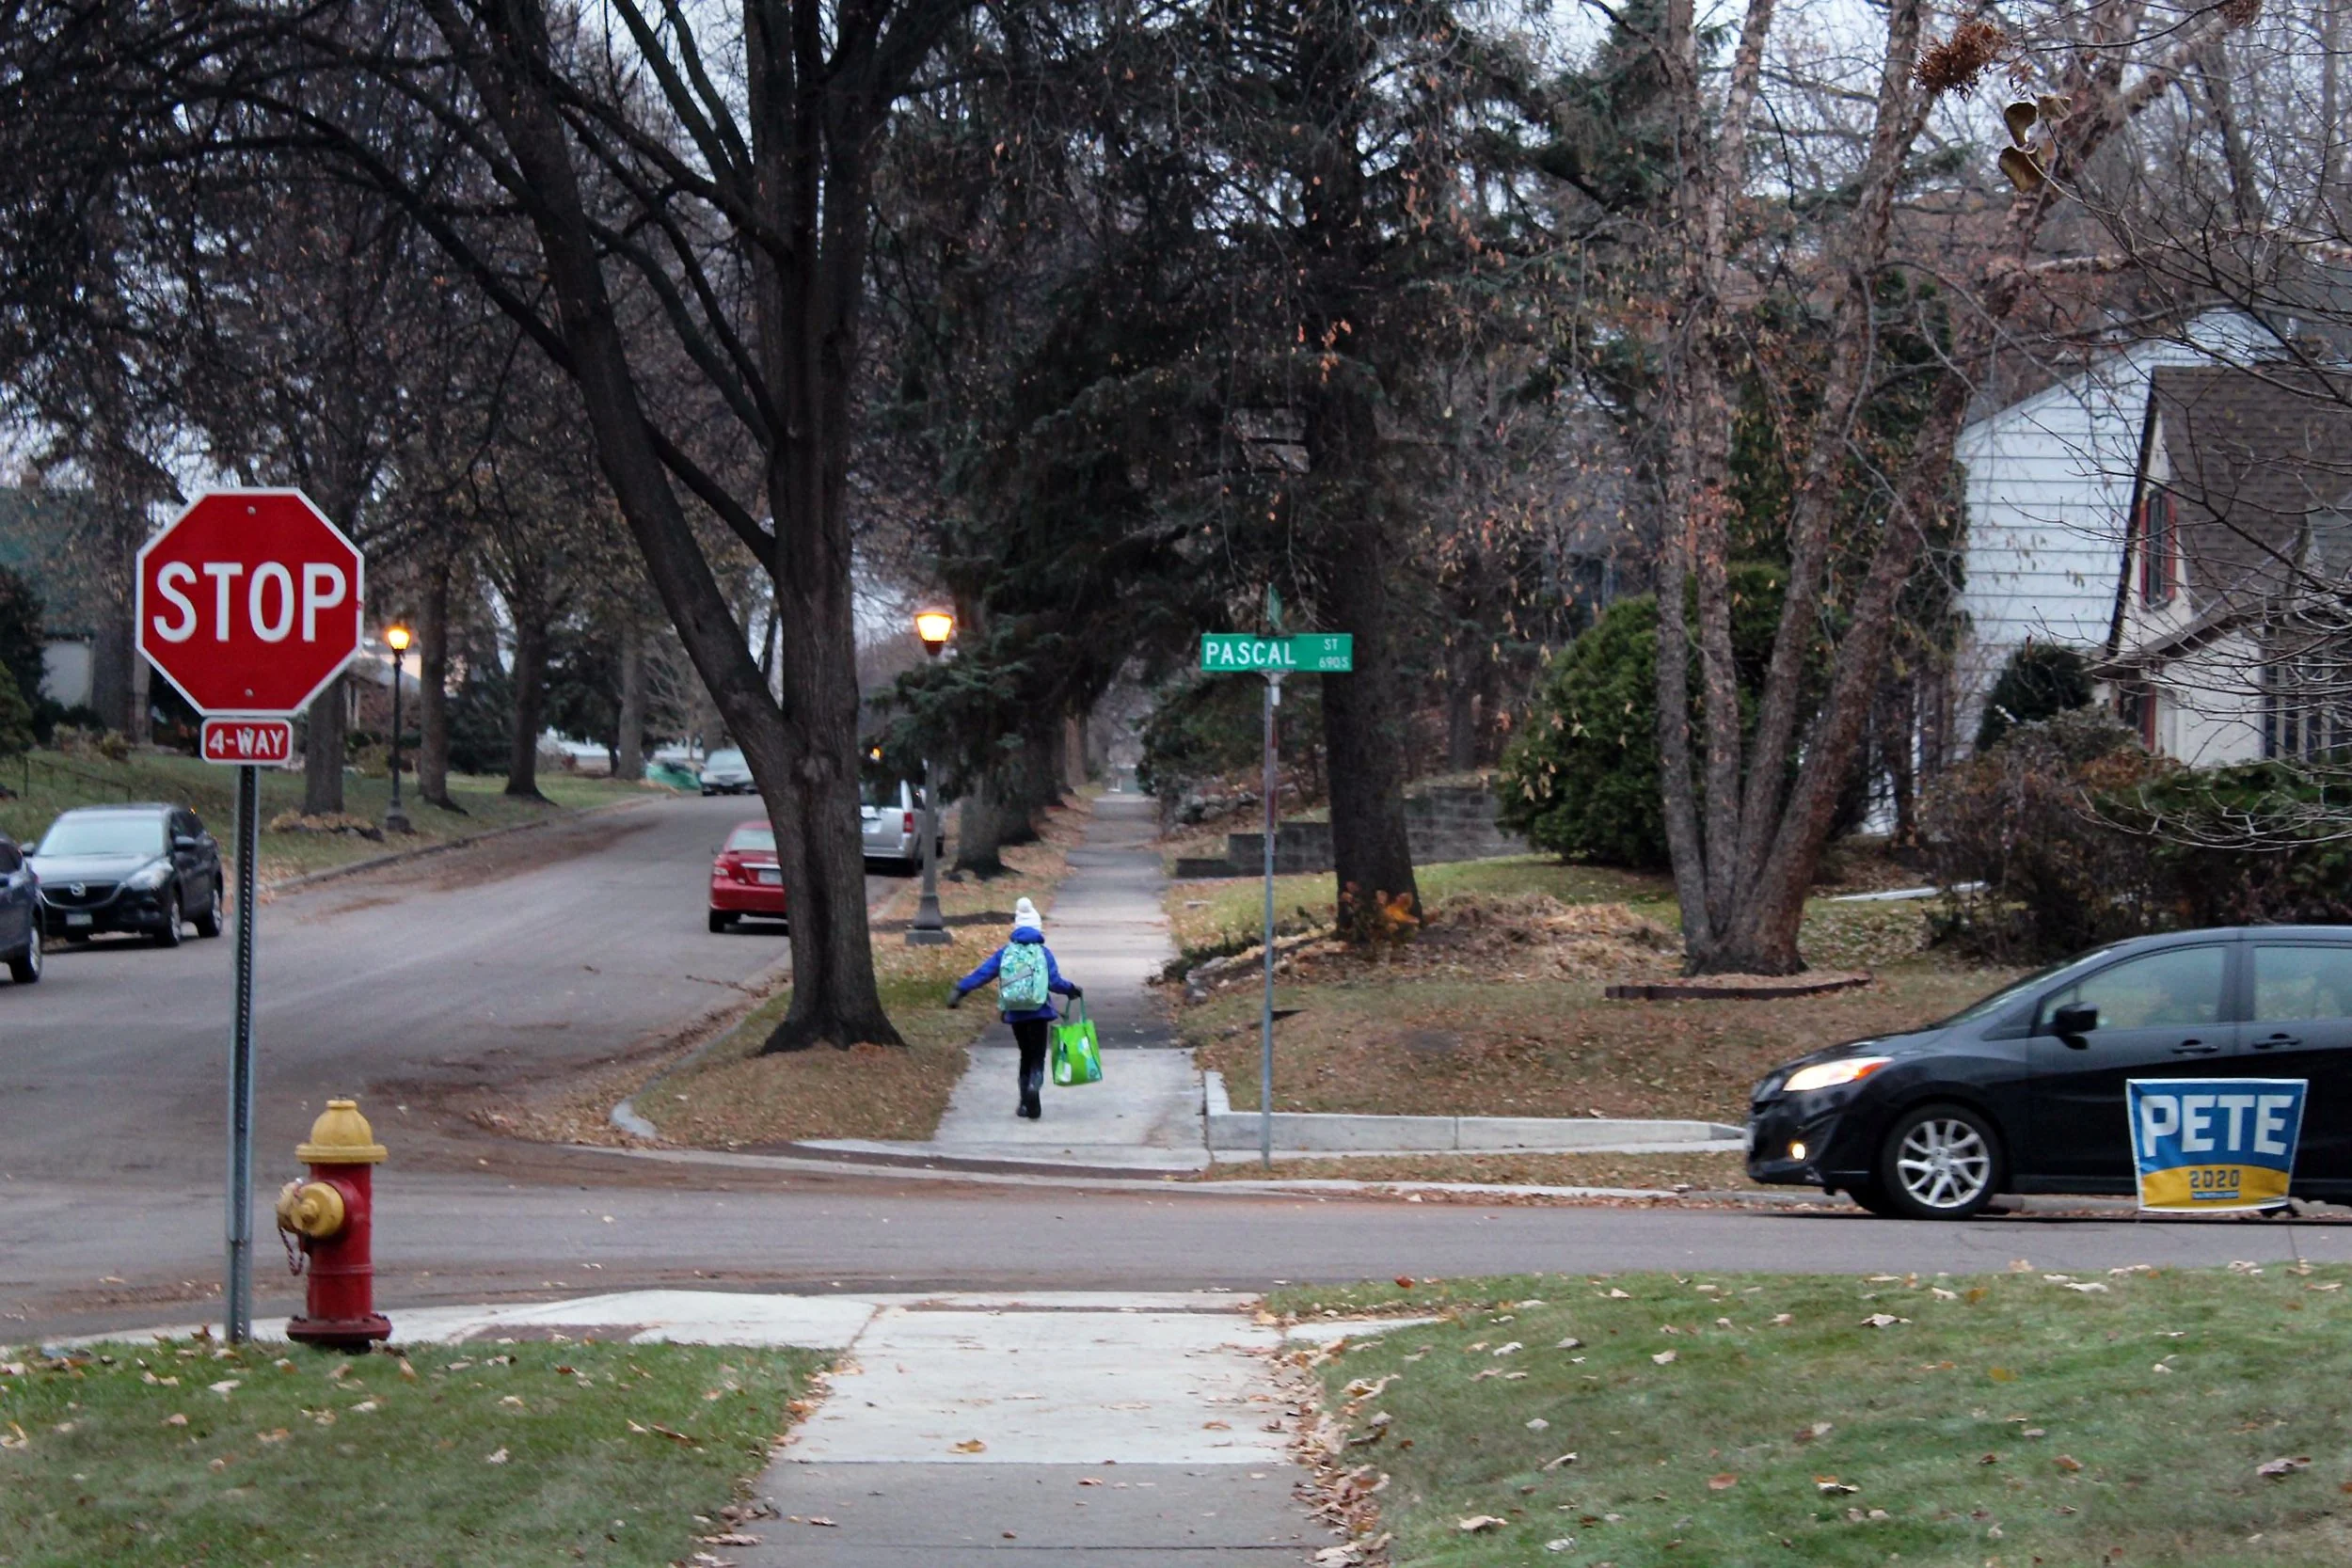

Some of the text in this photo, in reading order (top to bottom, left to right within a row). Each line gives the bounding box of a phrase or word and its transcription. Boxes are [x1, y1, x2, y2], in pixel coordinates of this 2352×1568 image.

[152, 561, 347, 643] STOP
[1206, 638, 1339, 665] PASCAL ST
[208, 727, 285, 756] 4-WAY
[2140, 1095, 2294, 1158] PETE
[2189, 1169, 2240, 1189] 2020
